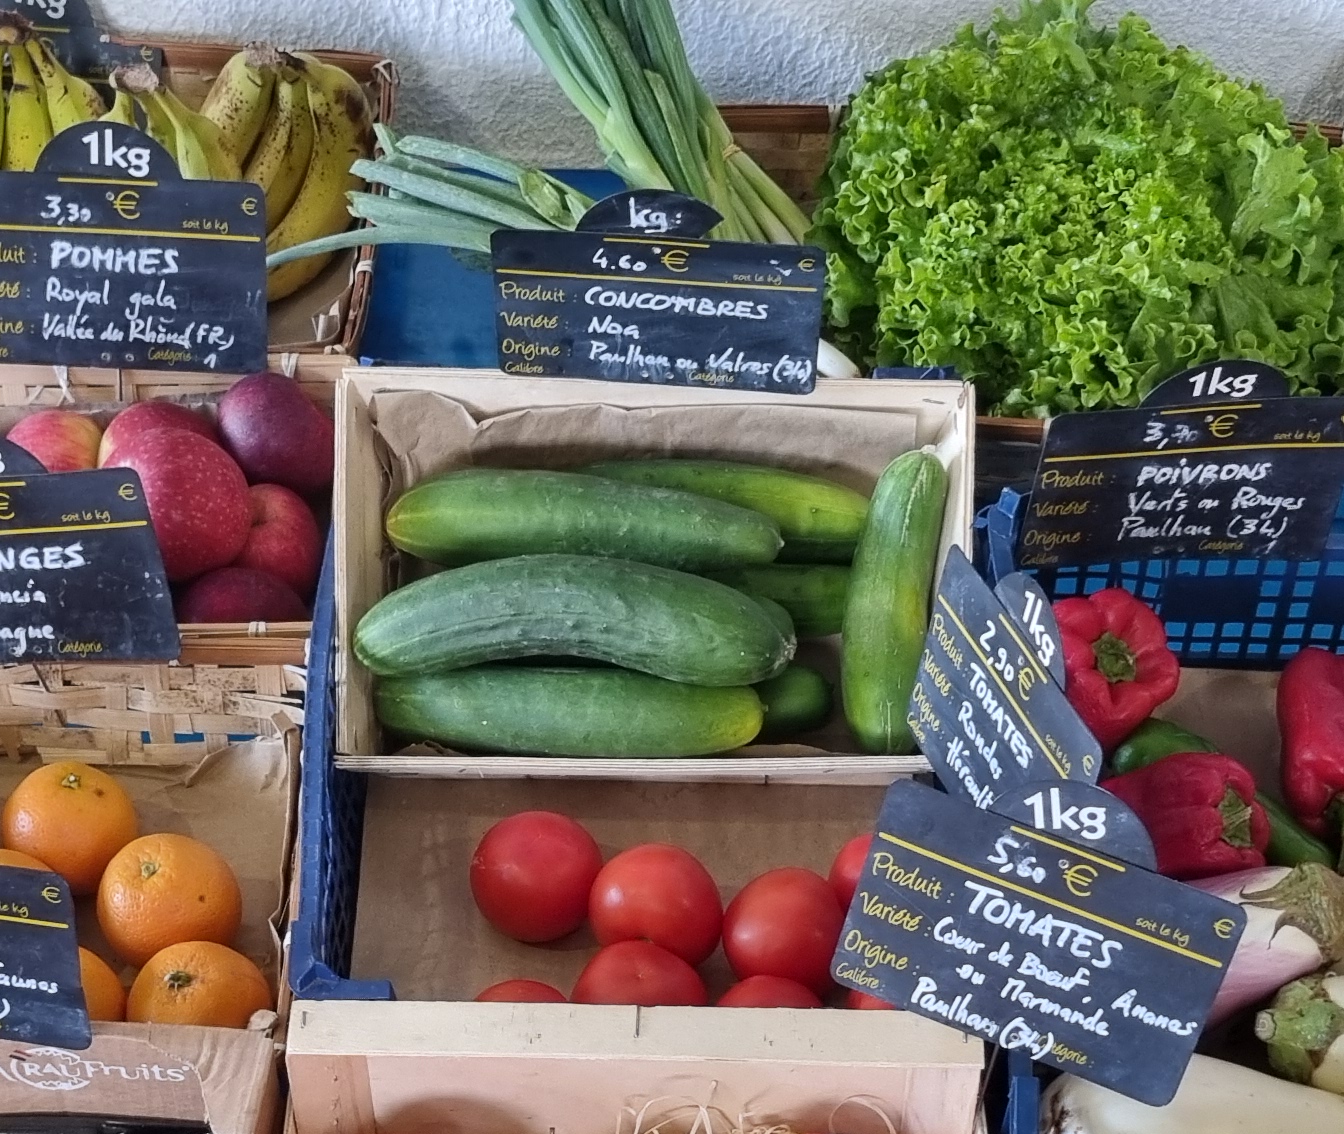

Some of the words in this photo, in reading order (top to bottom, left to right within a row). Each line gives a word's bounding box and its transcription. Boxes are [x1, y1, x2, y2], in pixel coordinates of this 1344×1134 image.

[82, 129, 151, 178] 1kg
[50, 240, 179, 274] POMMES
[46, 277, 109, 316] Royal
[124, 279, 177, 320] gala
[499, 281, 565, 303] Produit
[584, 286, 769, 320] CONCOMBRES
[588, 315, 640, 339] Noa
[502, 338, 560, 361] Origine
[1188, 367, 1258, 398] 1kg
[1041, 471, 1104, 489] Produit
[1024, 531, 1082, 550] Origine
[1022, 590, 1056, 667] 1kg
[969, 662, 1033, 769] TOMATES
[1024, 788, 1107, 840] 1kg
[871, 851, 944, 901] Produit
[963, 879, 1124, 970] TOMATES
[843, 928, 909, 973] Origine
